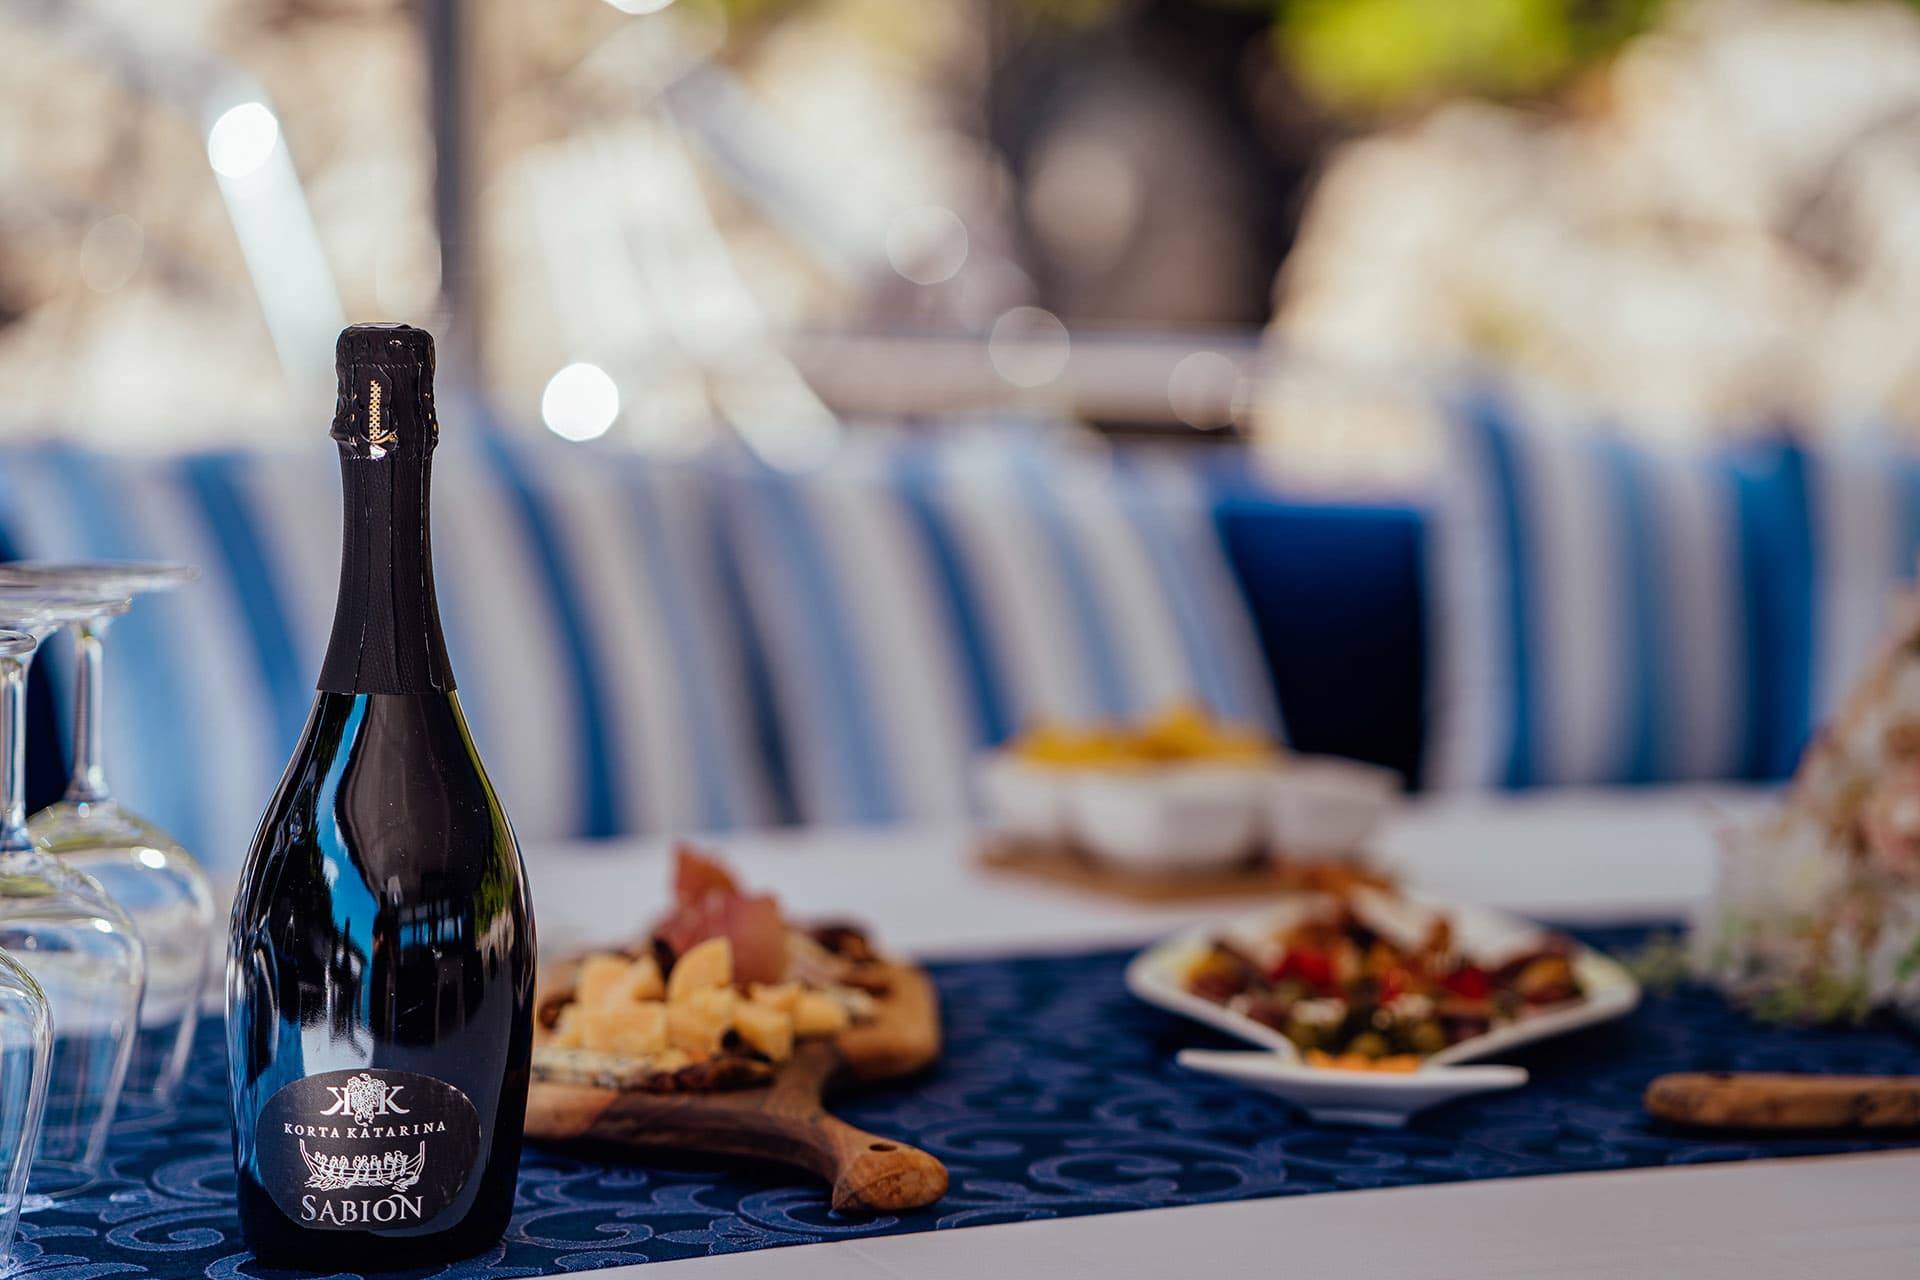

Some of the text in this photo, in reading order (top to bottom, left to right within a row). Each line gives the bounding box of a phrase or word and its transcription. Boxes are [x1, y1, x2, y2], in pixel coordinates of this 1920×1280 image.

[284, 1121, 446, 1138] KORTA KATARINA
[301, 1194, 425, 1226] SABION
